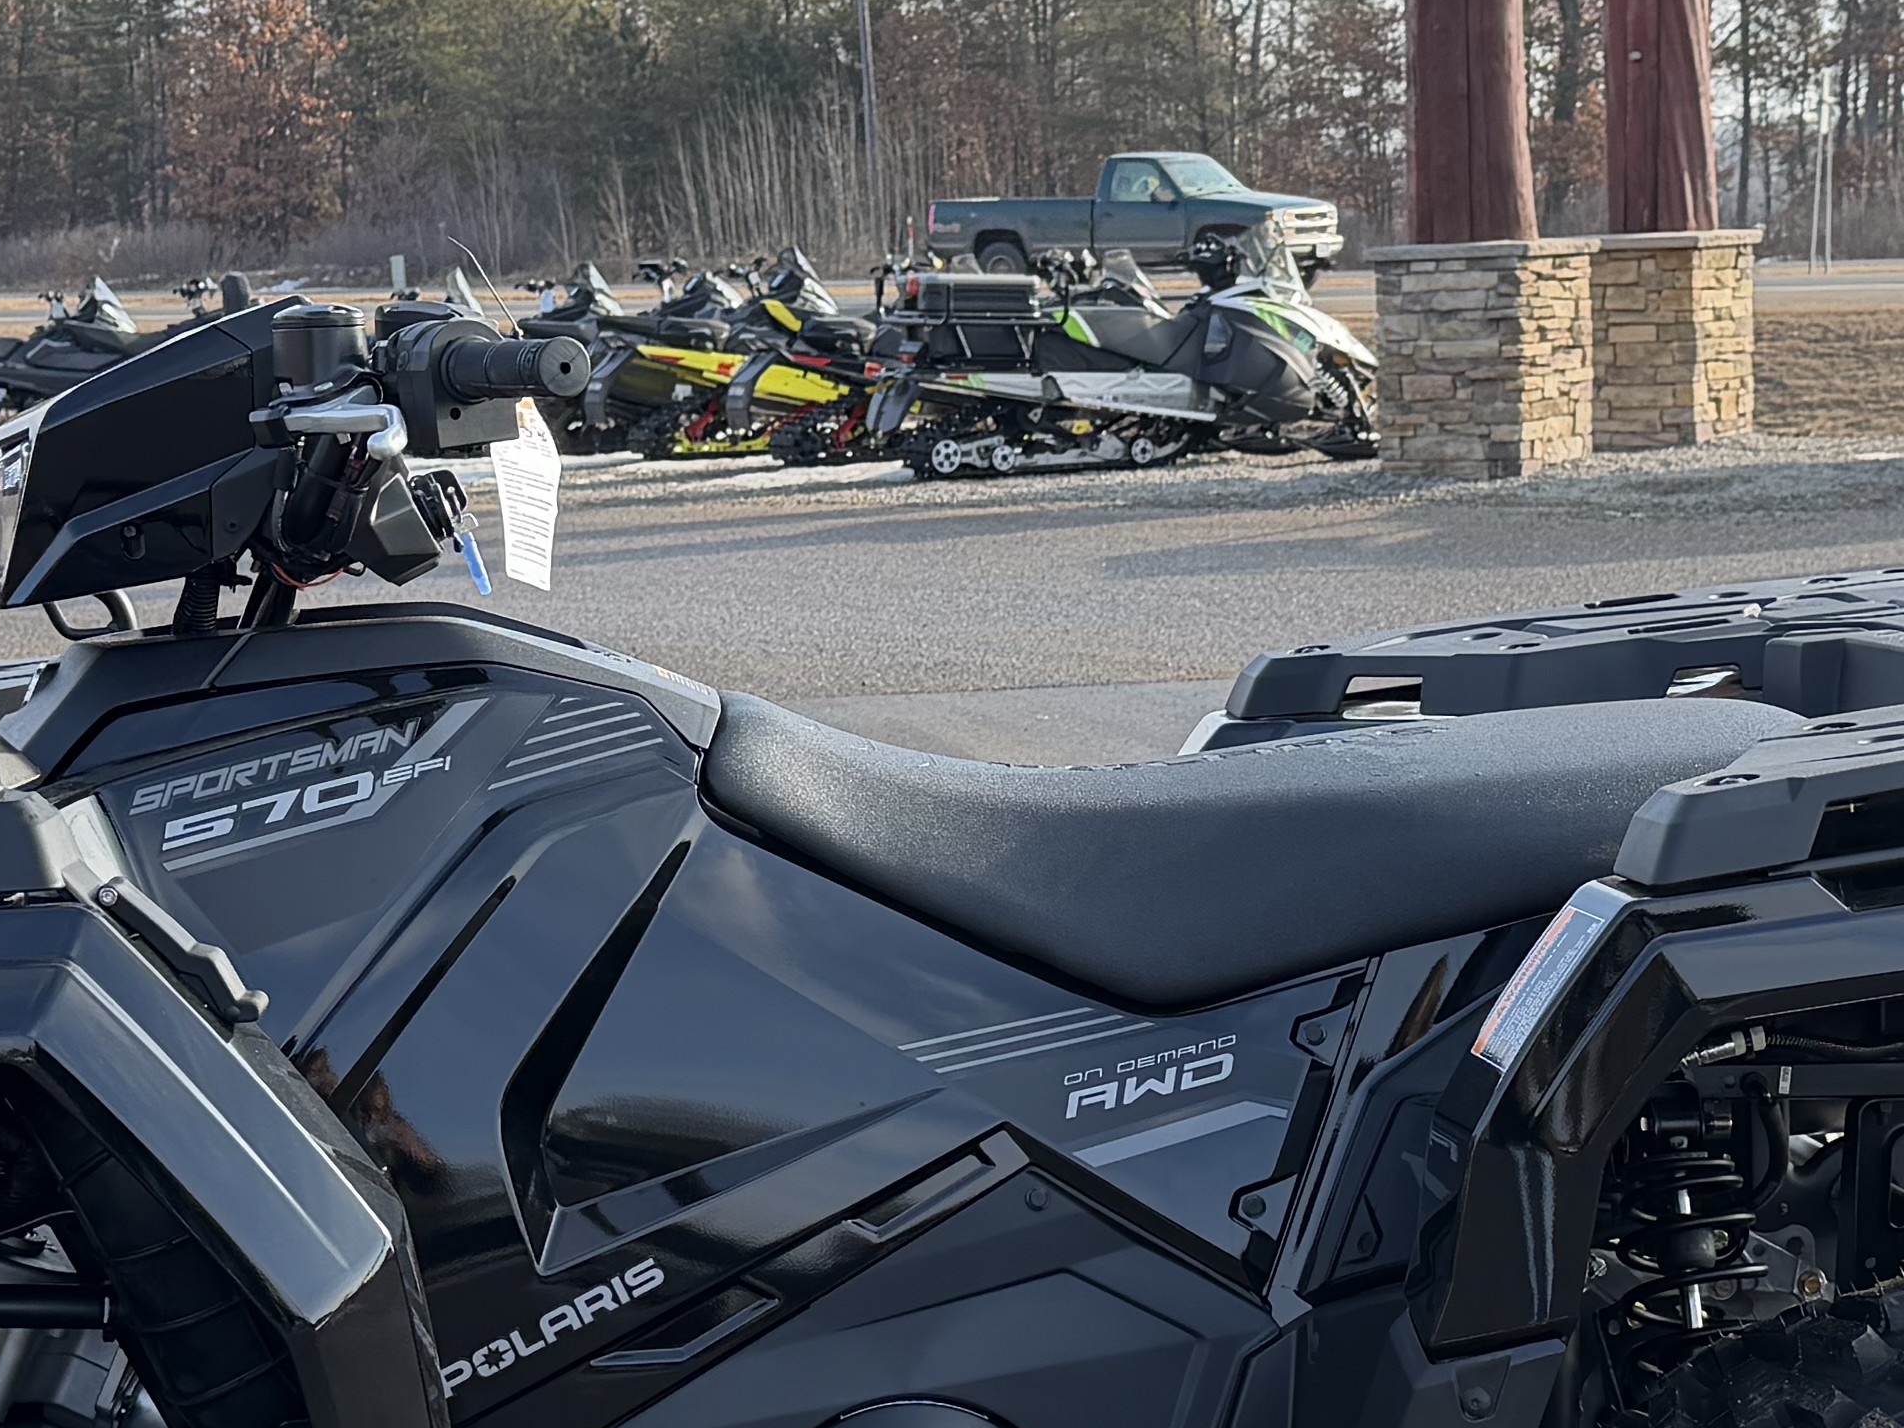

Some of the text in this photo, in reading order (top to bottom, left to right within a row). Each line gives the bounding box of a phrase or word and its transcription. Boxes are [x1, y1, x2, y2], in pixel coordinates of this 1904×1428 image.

[129, 717, 421, 816] SPORTSMAN
[162, 755, 452, 851] 570 EFI
[1063, 1034, 1237, 1086] ON DEMAND
[1065, 1052, 1235, 1120] AWD
[440, 1257, 665, 1399] POLARIS
